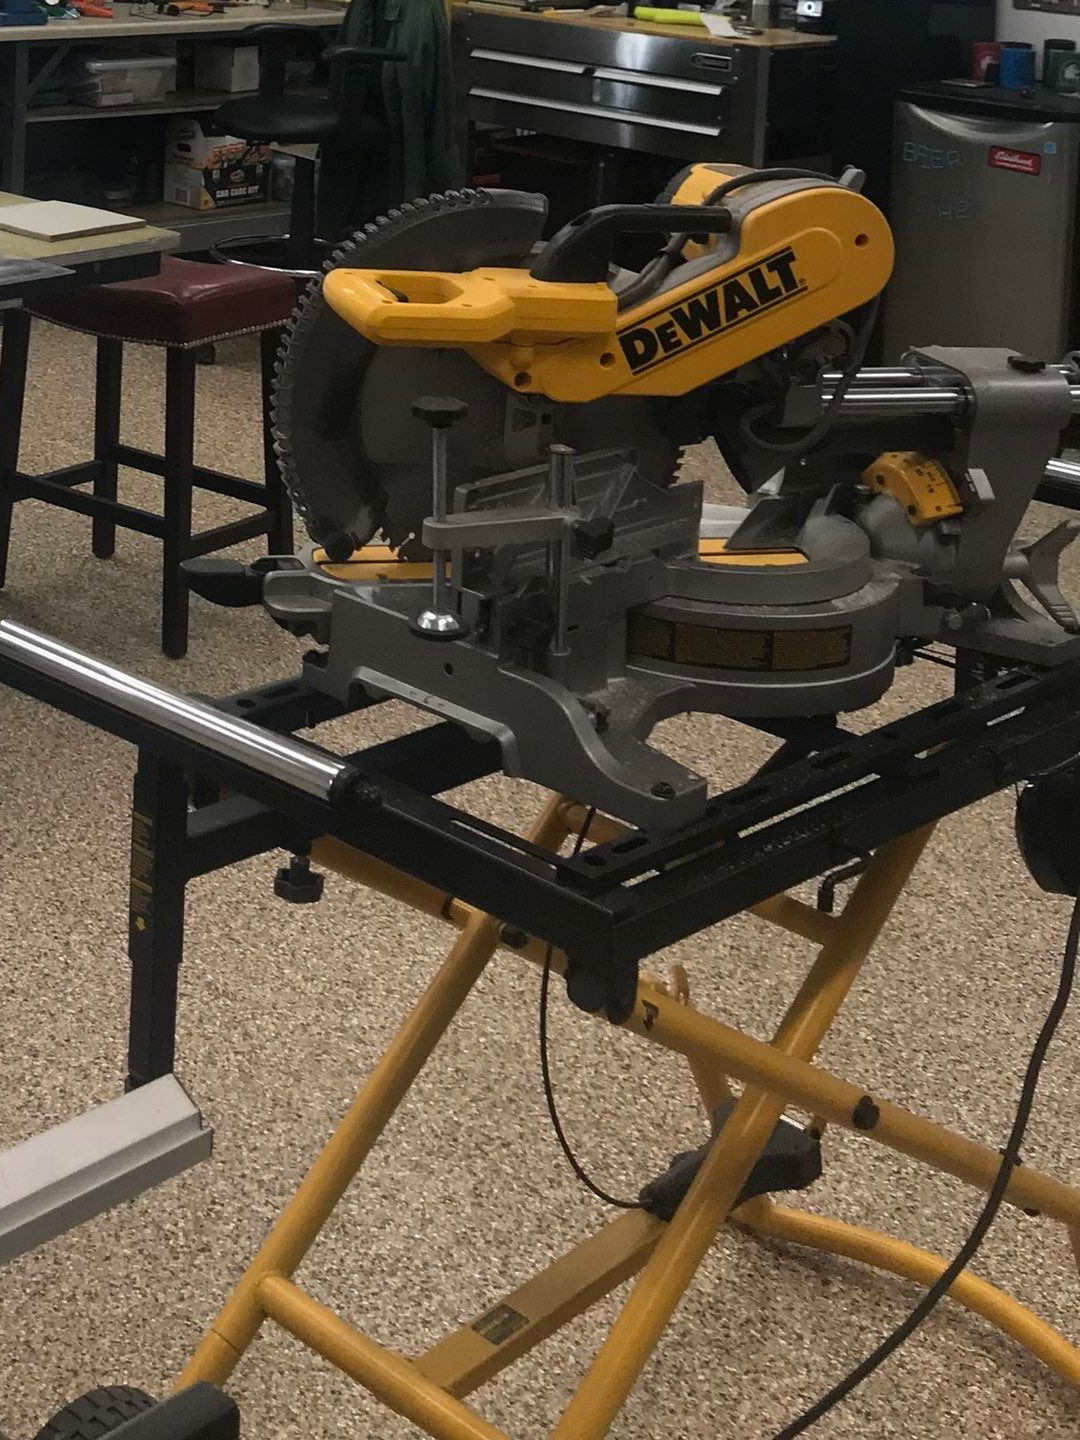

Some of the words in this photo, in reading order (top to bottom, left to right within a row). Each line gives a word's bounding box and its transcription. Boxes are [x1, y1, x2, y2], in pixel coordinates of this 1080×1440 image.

[904, 141, 964, 170] BEER
[216, 189, 229, 198] CAR
[230, 187, 247, 196] CARE
[248, 185, 259, 194] KIT
